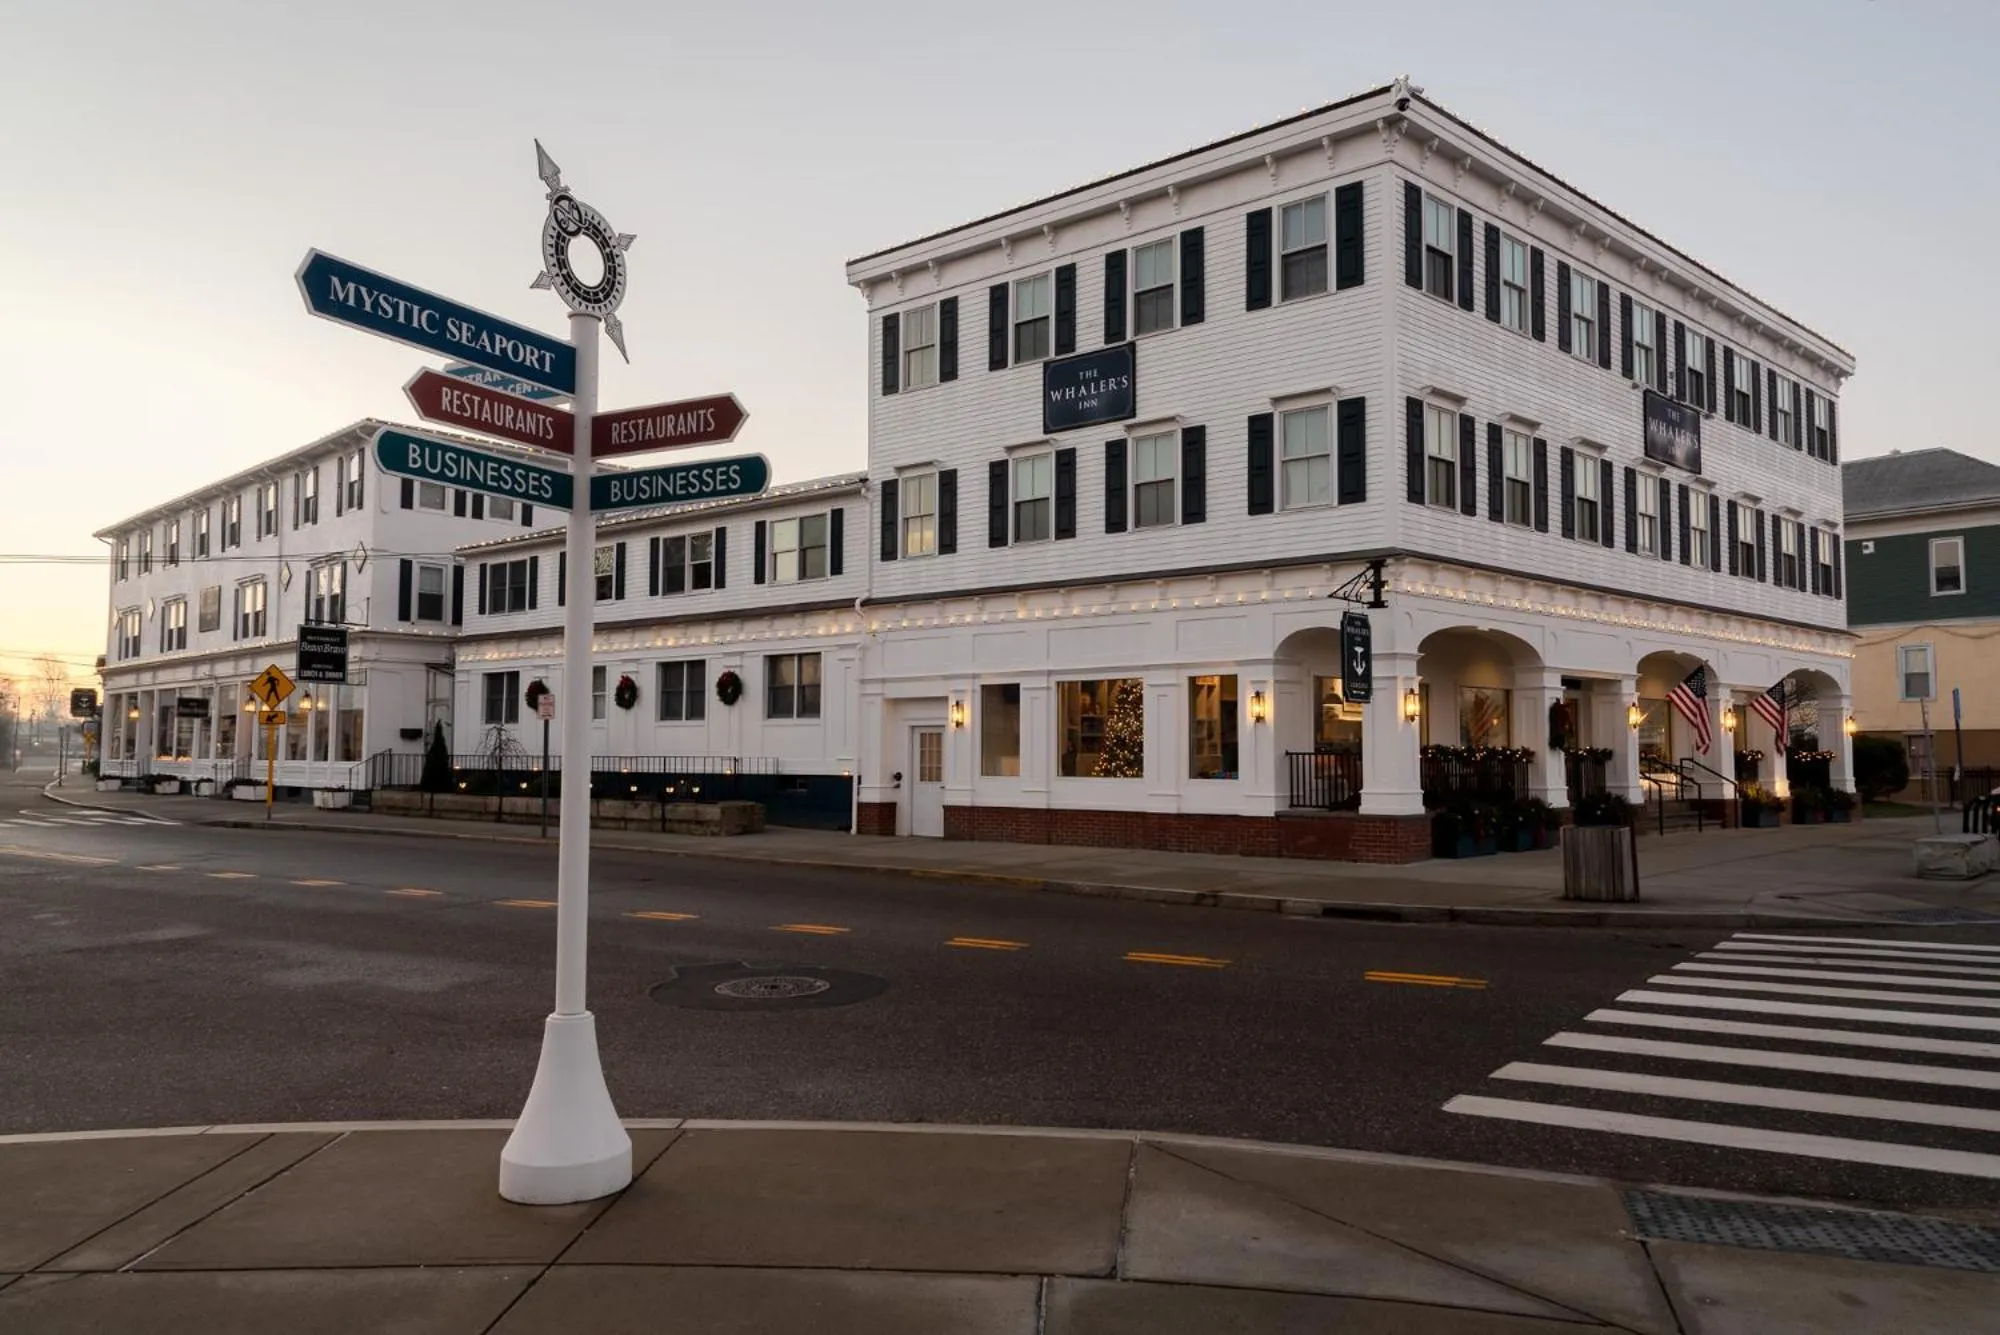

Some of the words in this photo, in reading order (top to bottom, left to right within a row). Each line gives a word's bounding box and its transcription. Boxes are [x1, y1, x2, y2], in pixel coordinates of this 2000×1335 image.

[329, 275, 439, 334] MYSTIC
[446, 317, 555, 373] SEAPORT
[1050, 375, 1129, 403] WHALER'S
[1079, 368, 1099, 380] THE
[441, 386, 554, 440] RESTAURANTS
[1079, 398, 1098, 410] INN
[611, 408, 716, 445] RESTAURANTS
[408, 443, 553, 499] BUSINESSES
[610, 465, 741, 502] BUSINESSES
